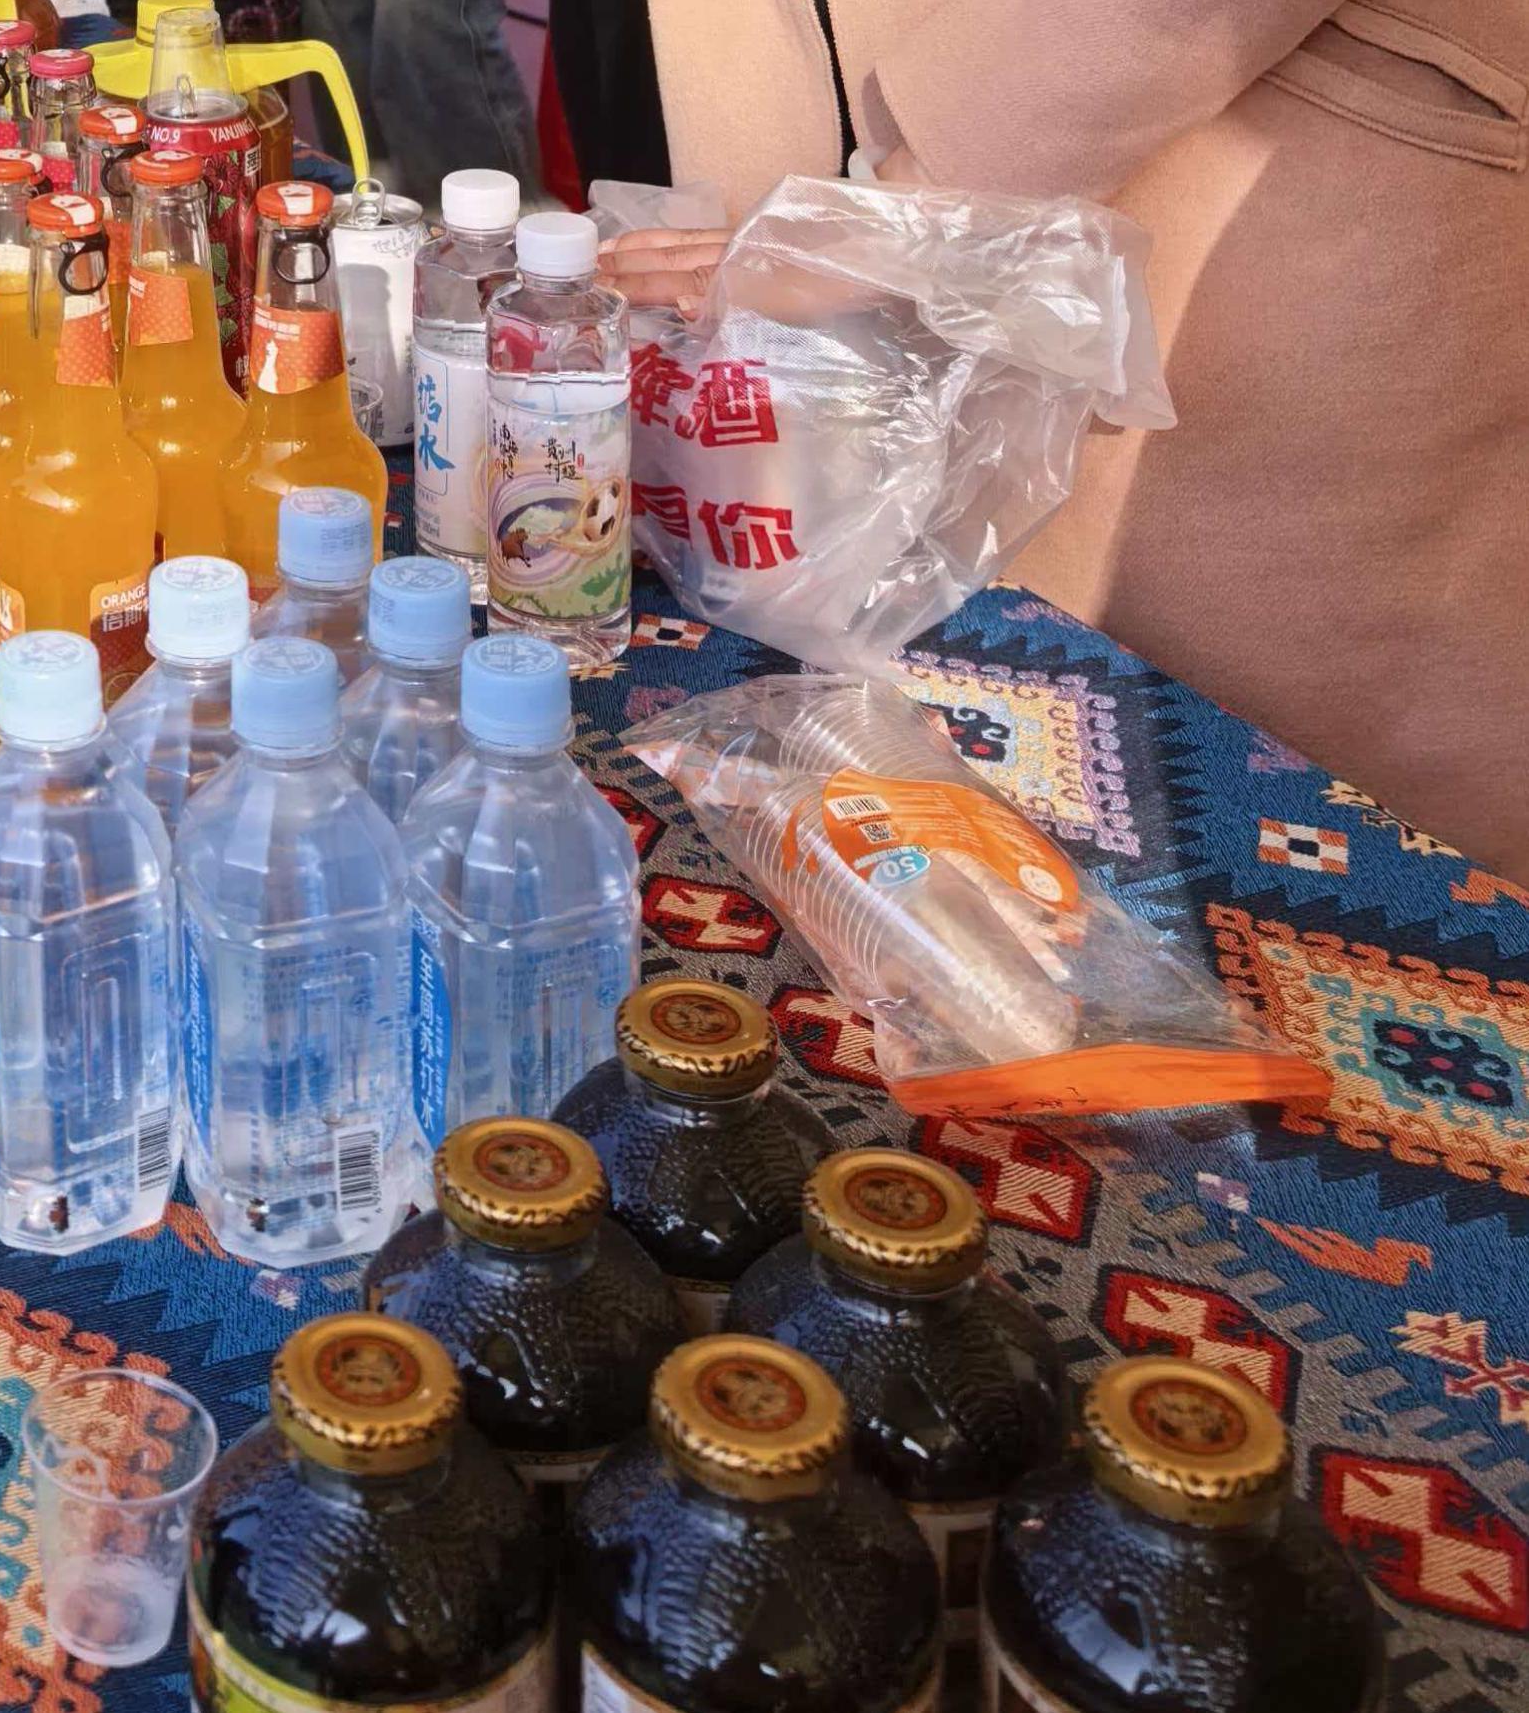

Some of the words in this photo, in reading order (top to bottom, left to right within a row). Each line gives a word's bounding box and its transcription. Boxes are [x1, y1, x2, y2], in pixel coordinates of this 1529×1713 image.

[150, 125, 181, 144] NO.9
[100, 582, 147, 609] ORANGE
[882, 856, 918, 880] 50
